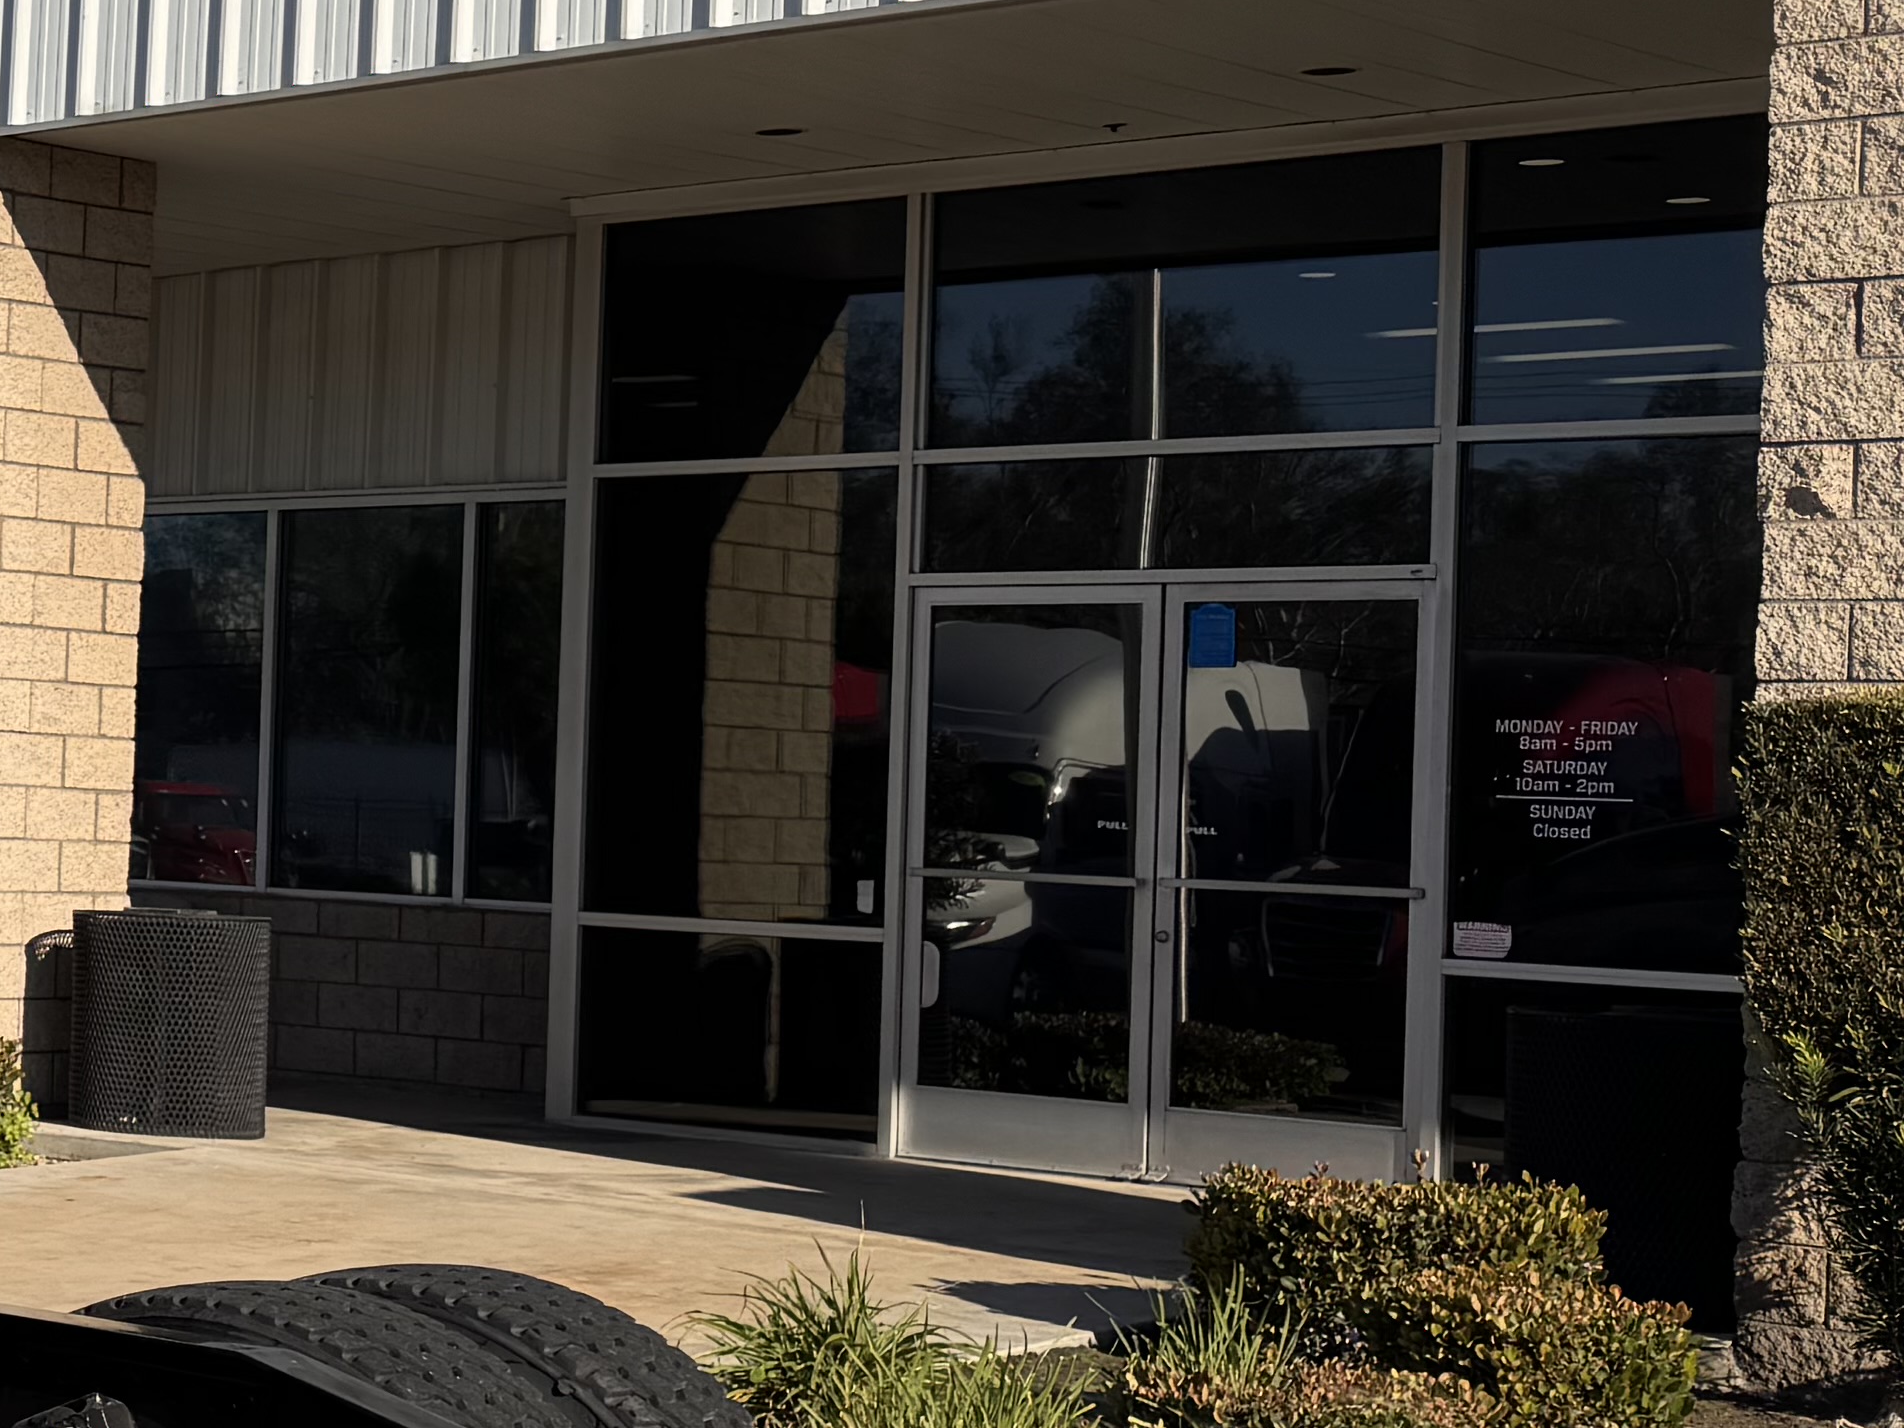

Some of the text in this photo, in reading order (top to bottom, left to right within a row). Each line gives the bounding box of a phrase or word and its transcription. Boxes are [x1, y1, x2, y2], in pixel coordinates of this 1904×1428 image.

[1495, 719, 1564, 735] MONDAY
[1580, 721, 1639, 736] FRIDAY
[1519, 736, 1557, 750] 8am
[1574, 737, 1612, 754] 5pm
[1523, 759, 1608, 776] SATURDAY
[1515, 777, 1559, 792] 10am
[1576, 779, 1615, 795] 2pm
[1529, 804, 1596, 820] SUNDAY
[1097, 820, 1129, 830] PULL
[1533, 823, 1591, 839] Closed
